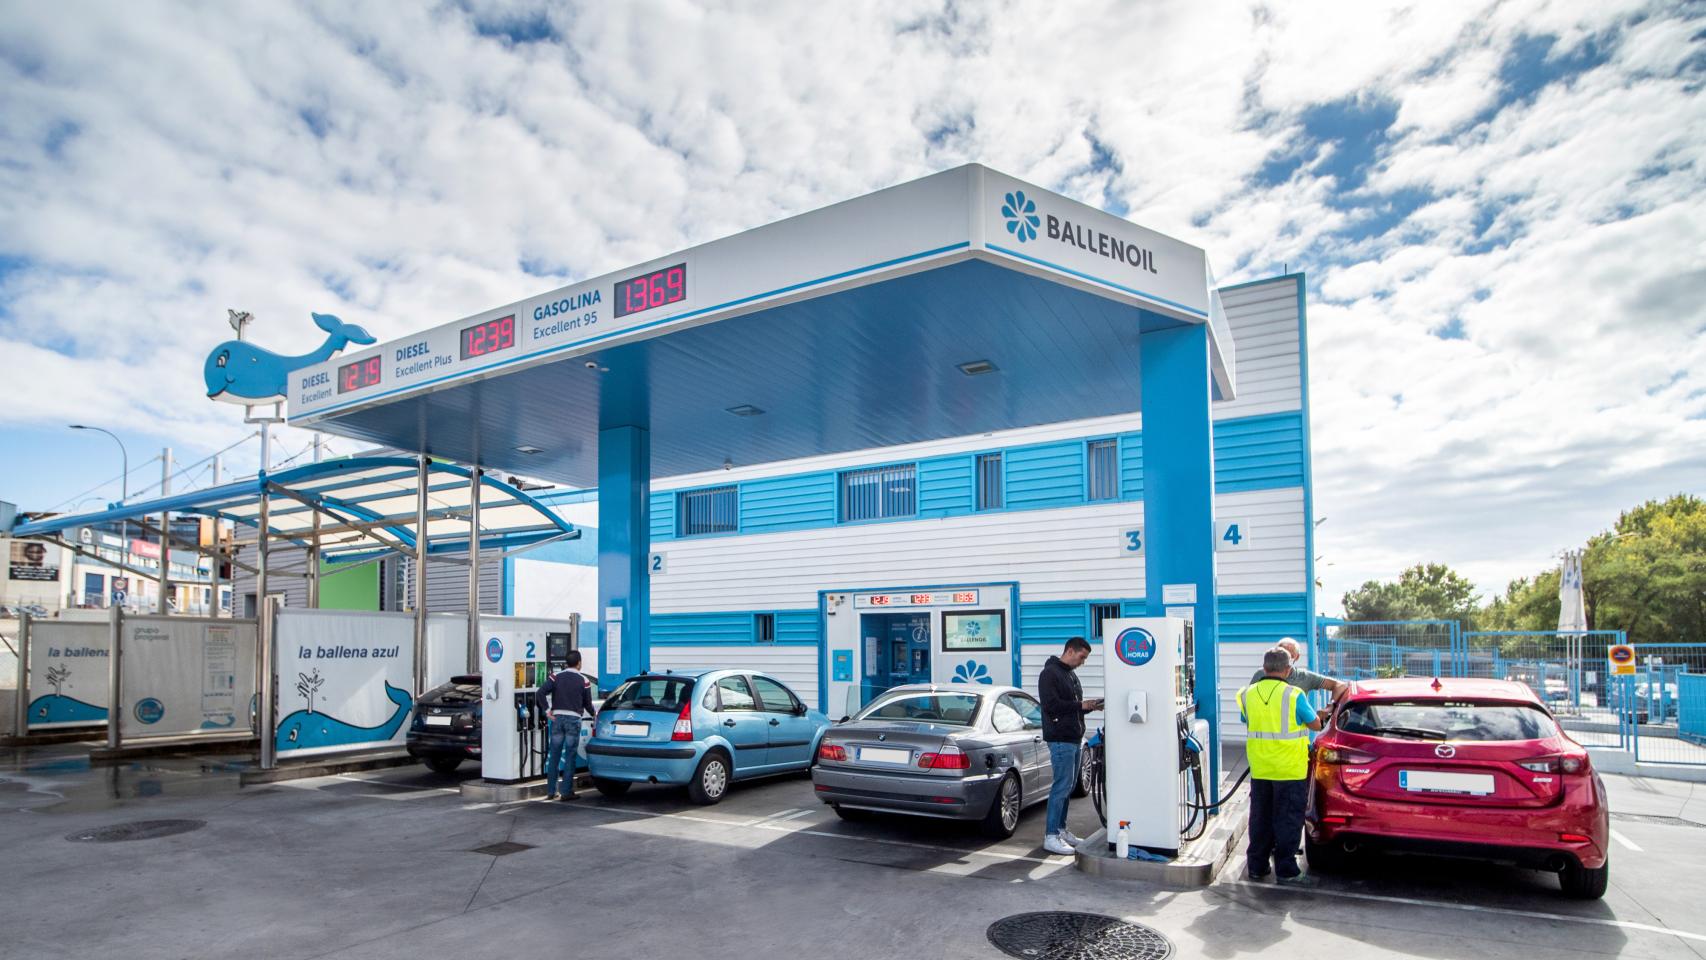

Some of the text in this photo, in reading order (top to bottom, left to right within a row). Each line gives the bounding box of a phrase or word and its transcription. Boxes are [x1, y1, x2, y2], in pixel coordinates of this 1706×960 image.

[1046, 214, 1158, 274] BALLENOIL
[533, 290, 602, 321] GASOLINA
[533, 311, 598, 340] Excellent 95
[396, 341, 430, 362] DIESEL
[395, 354, 453, 378] Excellent Plus
[302, 371, 331, 390] DIESEL
[301, 388, 332, 405] Excellent
[1126, 530, 1142, 551] 3
[1223, 524, 1242, 545] 4
[652, 555, 662, 571] 2
[48, 647, 61, 658] la
[298, 644, 400, 660] la ballena azul
[525, 641, 536, 659] 2
[1127, 639, 1149, 652] 24
